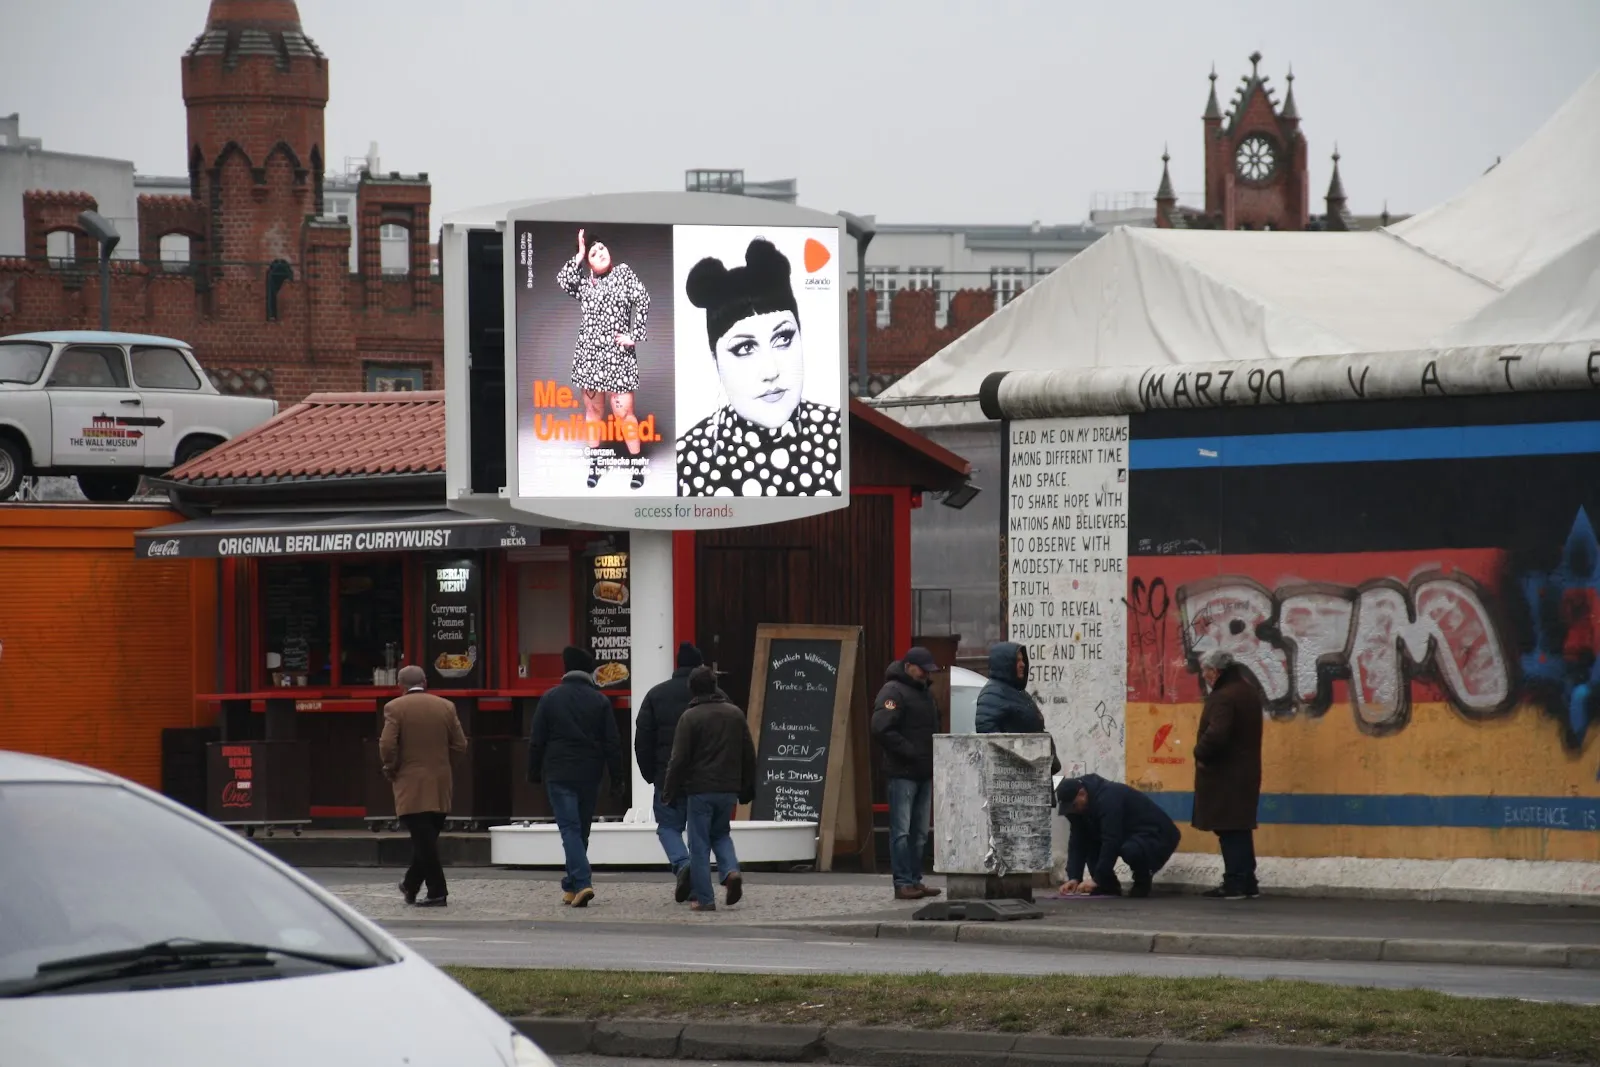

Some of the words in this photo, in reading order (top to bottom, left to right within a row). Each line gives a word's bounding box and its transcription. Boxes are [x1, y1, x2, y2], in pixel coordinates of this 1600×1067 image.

[533, 379, 579, 408] Me.
[533, 413, 662, 442] Unlimited.
[1012, 430, 1036, 444] LEAD
[1040, 430, 1055, 444] ME
[1060, 430, 1074, 443] ON
[1076, 428, 1090, 442] MY
[1092, 426, 1128, 442] DREAMS
[70, 438, 83, 446] THE
[86, 438, 104, 446] WALL
[106, 439, 138, 448] MUSEUM
[597, 457, 630, 466] Entdecke
[631, 457, 650, 466] mehr
[1012, 451, 1041, 466] AMONG
[1046, 449, 1093, 465] DIFFERENT
[1098, 448, 1122, 463] TIME
[1012, 474, 1032, 488] AND
[1011, 494, 1024, 510] TO
[1028, 494, 1058, 508] SHARE
[1064, 494, 1089, 508] HOPE
[1095, 492, 1122, 507] WITH
[634, 506, 672, 518] access
[674, 504, 691, 518] for
[694, 504, 734, 518] brands
[1010, 516, 1048, 531] NATIONS
[1052, 516, 1070, 530] AND
[1076, 514, 1128, 530] BELIEVERS.
[218, 536, 282, 555] ORIGINAL
[285, 533, 353, 553] BERLINER
[355, 530, 452, 550] CURRYWURST
[500, 536, 526, 546] BECK'S
[1011, 537, 1024, 552] TO
[1028, 536, 1076, 552] OBSERVE
[1082, 536, 1110, 551] WITH
[594, 554, 628, 567] CURRY
[1012, 558, 1062, 574] MODESTY
[1069, 558, 1088, 573] THE
[1094, 558, 1122, 572] PURE
[436, 568, 470, 580] BERLIN
[594, 568, 628, 580] WURST
[431, 604, 467, 616] Currywurst
[1012, 602, 1034, 617] AND
[1040, 602, 1054, 616] TO
[1062, 601, 1102, 616] REVEAL
[438, 617, 464, 627] Pommes
[1012, 624, 1074, 638] PRUDENTLY
[1081, 622, 1102, 638] THE
[595, 648, 629, 660] FRITES
[1030, 644, 1046, 660] GIC
[1053, 644, 1074, 660] AND
[1081, 643, 1102, 660] THE
[772, 652, 800, 670] Herzlich
[1028, 666, 1065, 682] STERY
[778, 744, 810, 755] OPEN
[767, 770, 784, 780] Hot
[1504, 806, 1570, 825] EXISTENCE
